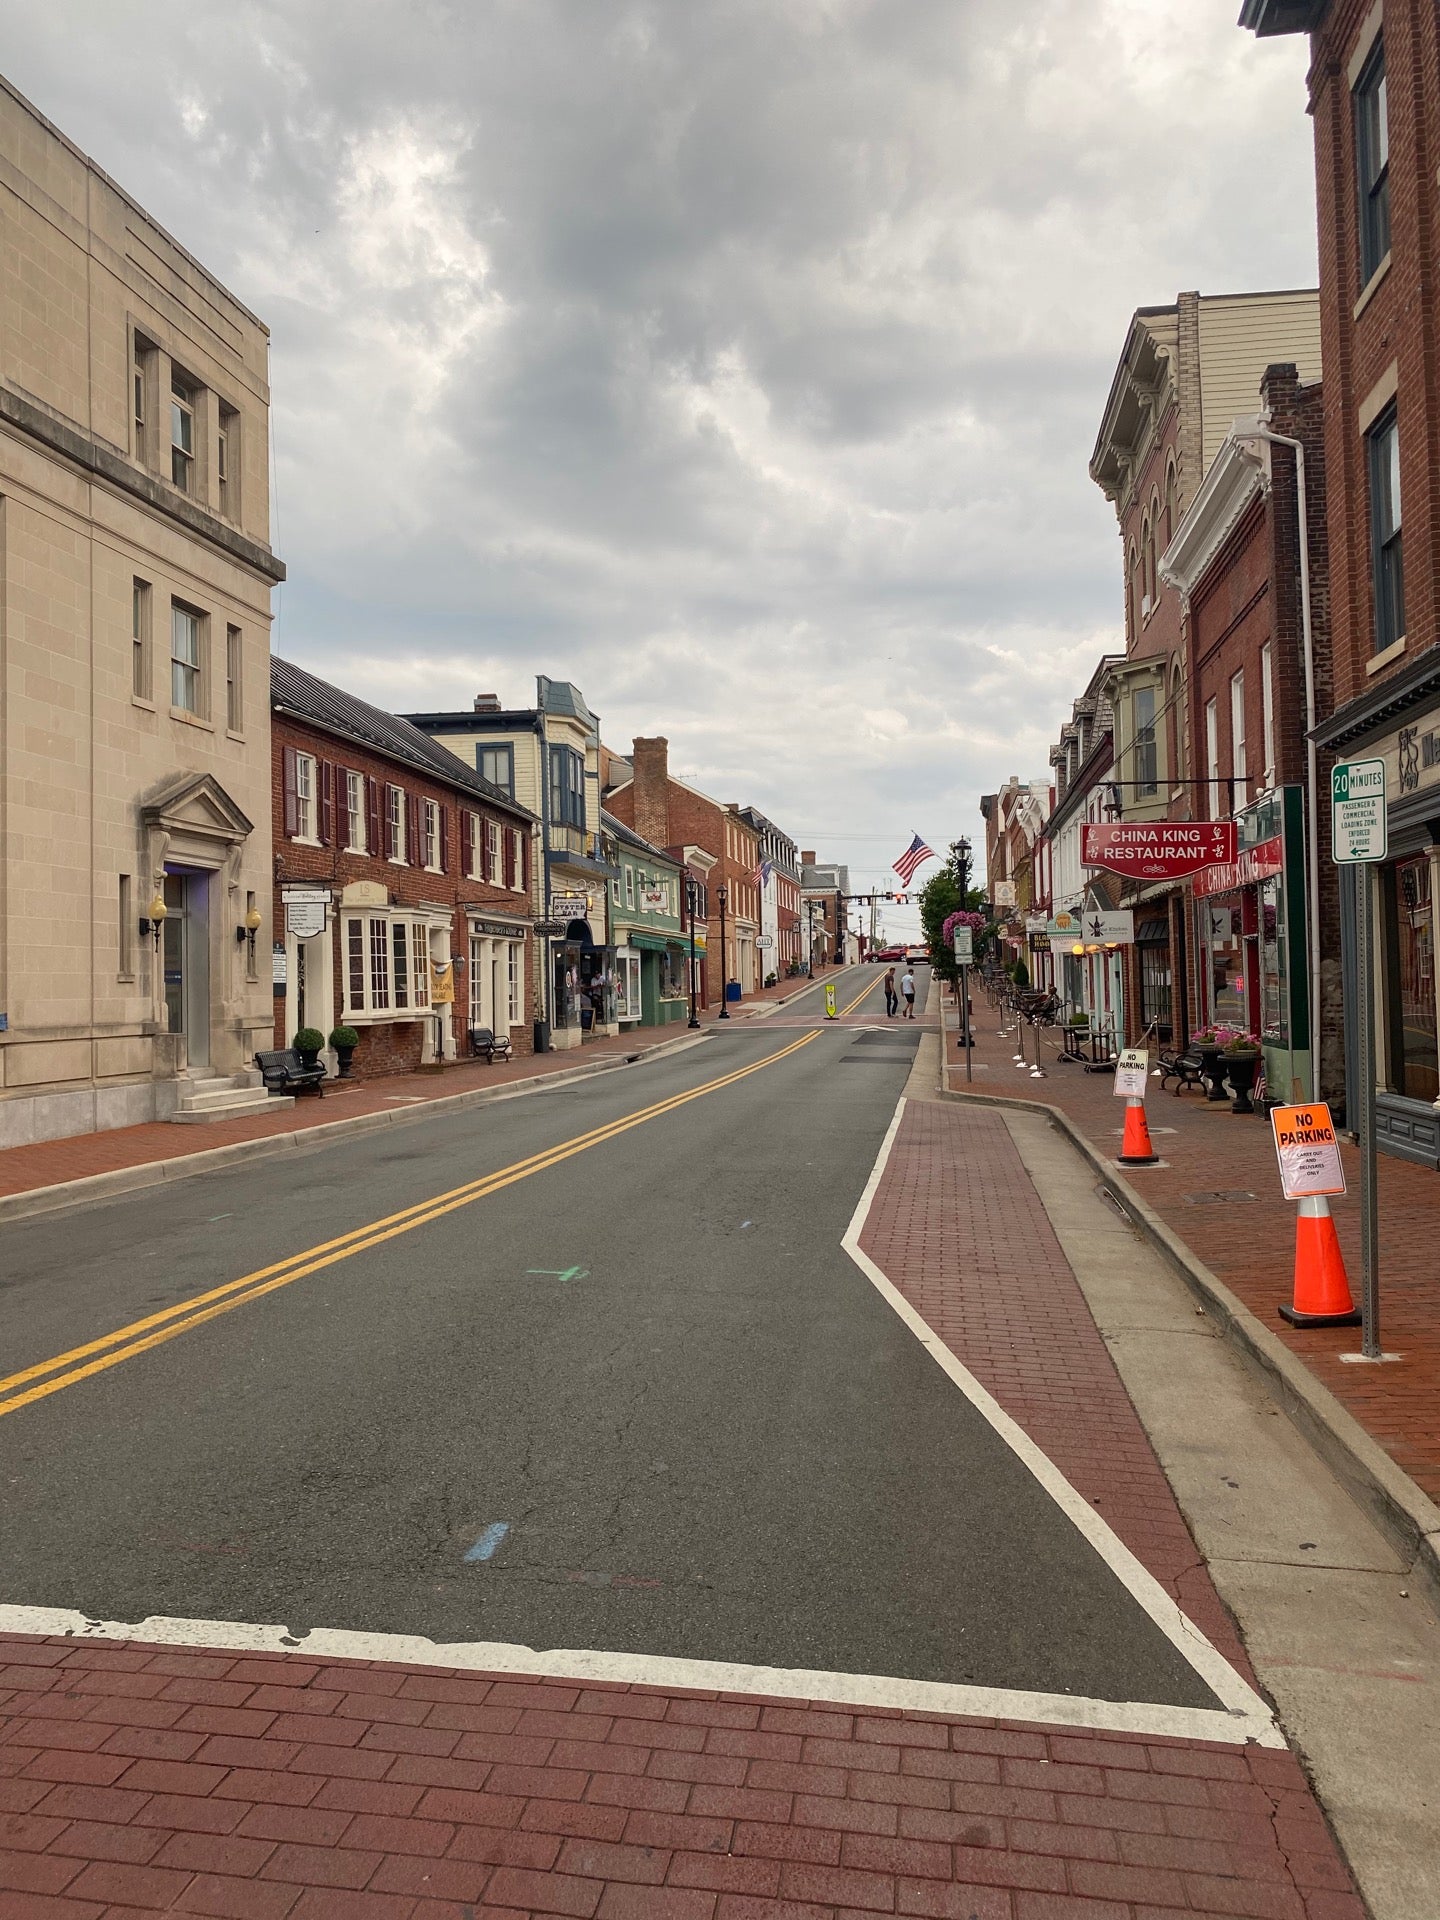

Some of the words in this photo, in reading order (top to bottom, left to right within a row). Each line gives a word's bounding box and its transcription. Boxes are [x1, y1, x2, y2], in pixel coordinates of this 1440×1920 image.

[1334, 774, 1348, 793] 20
[1350, 772, 1382, 789] MINUTES
[1342, 801, 1371, 811] PASSENGER
[1342, 810, 1375, 820] COMMERCIAL
[1341, 820, 1363, 830] LOADING
[1364, 818, 1378, 827] ZONE
[1110, 830, 1159, 843] CHINA
[1163, 829, 1201, 842] KING
[1348, 828, 1371, 838] ENFORCED
[1349, 839, 1355, 847] 24
[1355, 838, 1370, 846] HOURS
[1104, 847, 1208, 859] RESTAURANT
[1207, 864, 1232, 892] CHINA
[1236, 849, 1259, 887] KING
[1127, 1053, 1137, 1061] NO
[1119, 1062, 1145, 1070] PARKING
[1295, 1113, 1313, 1127] NO
[1279, 1128, 1332, 1146] PARKING
